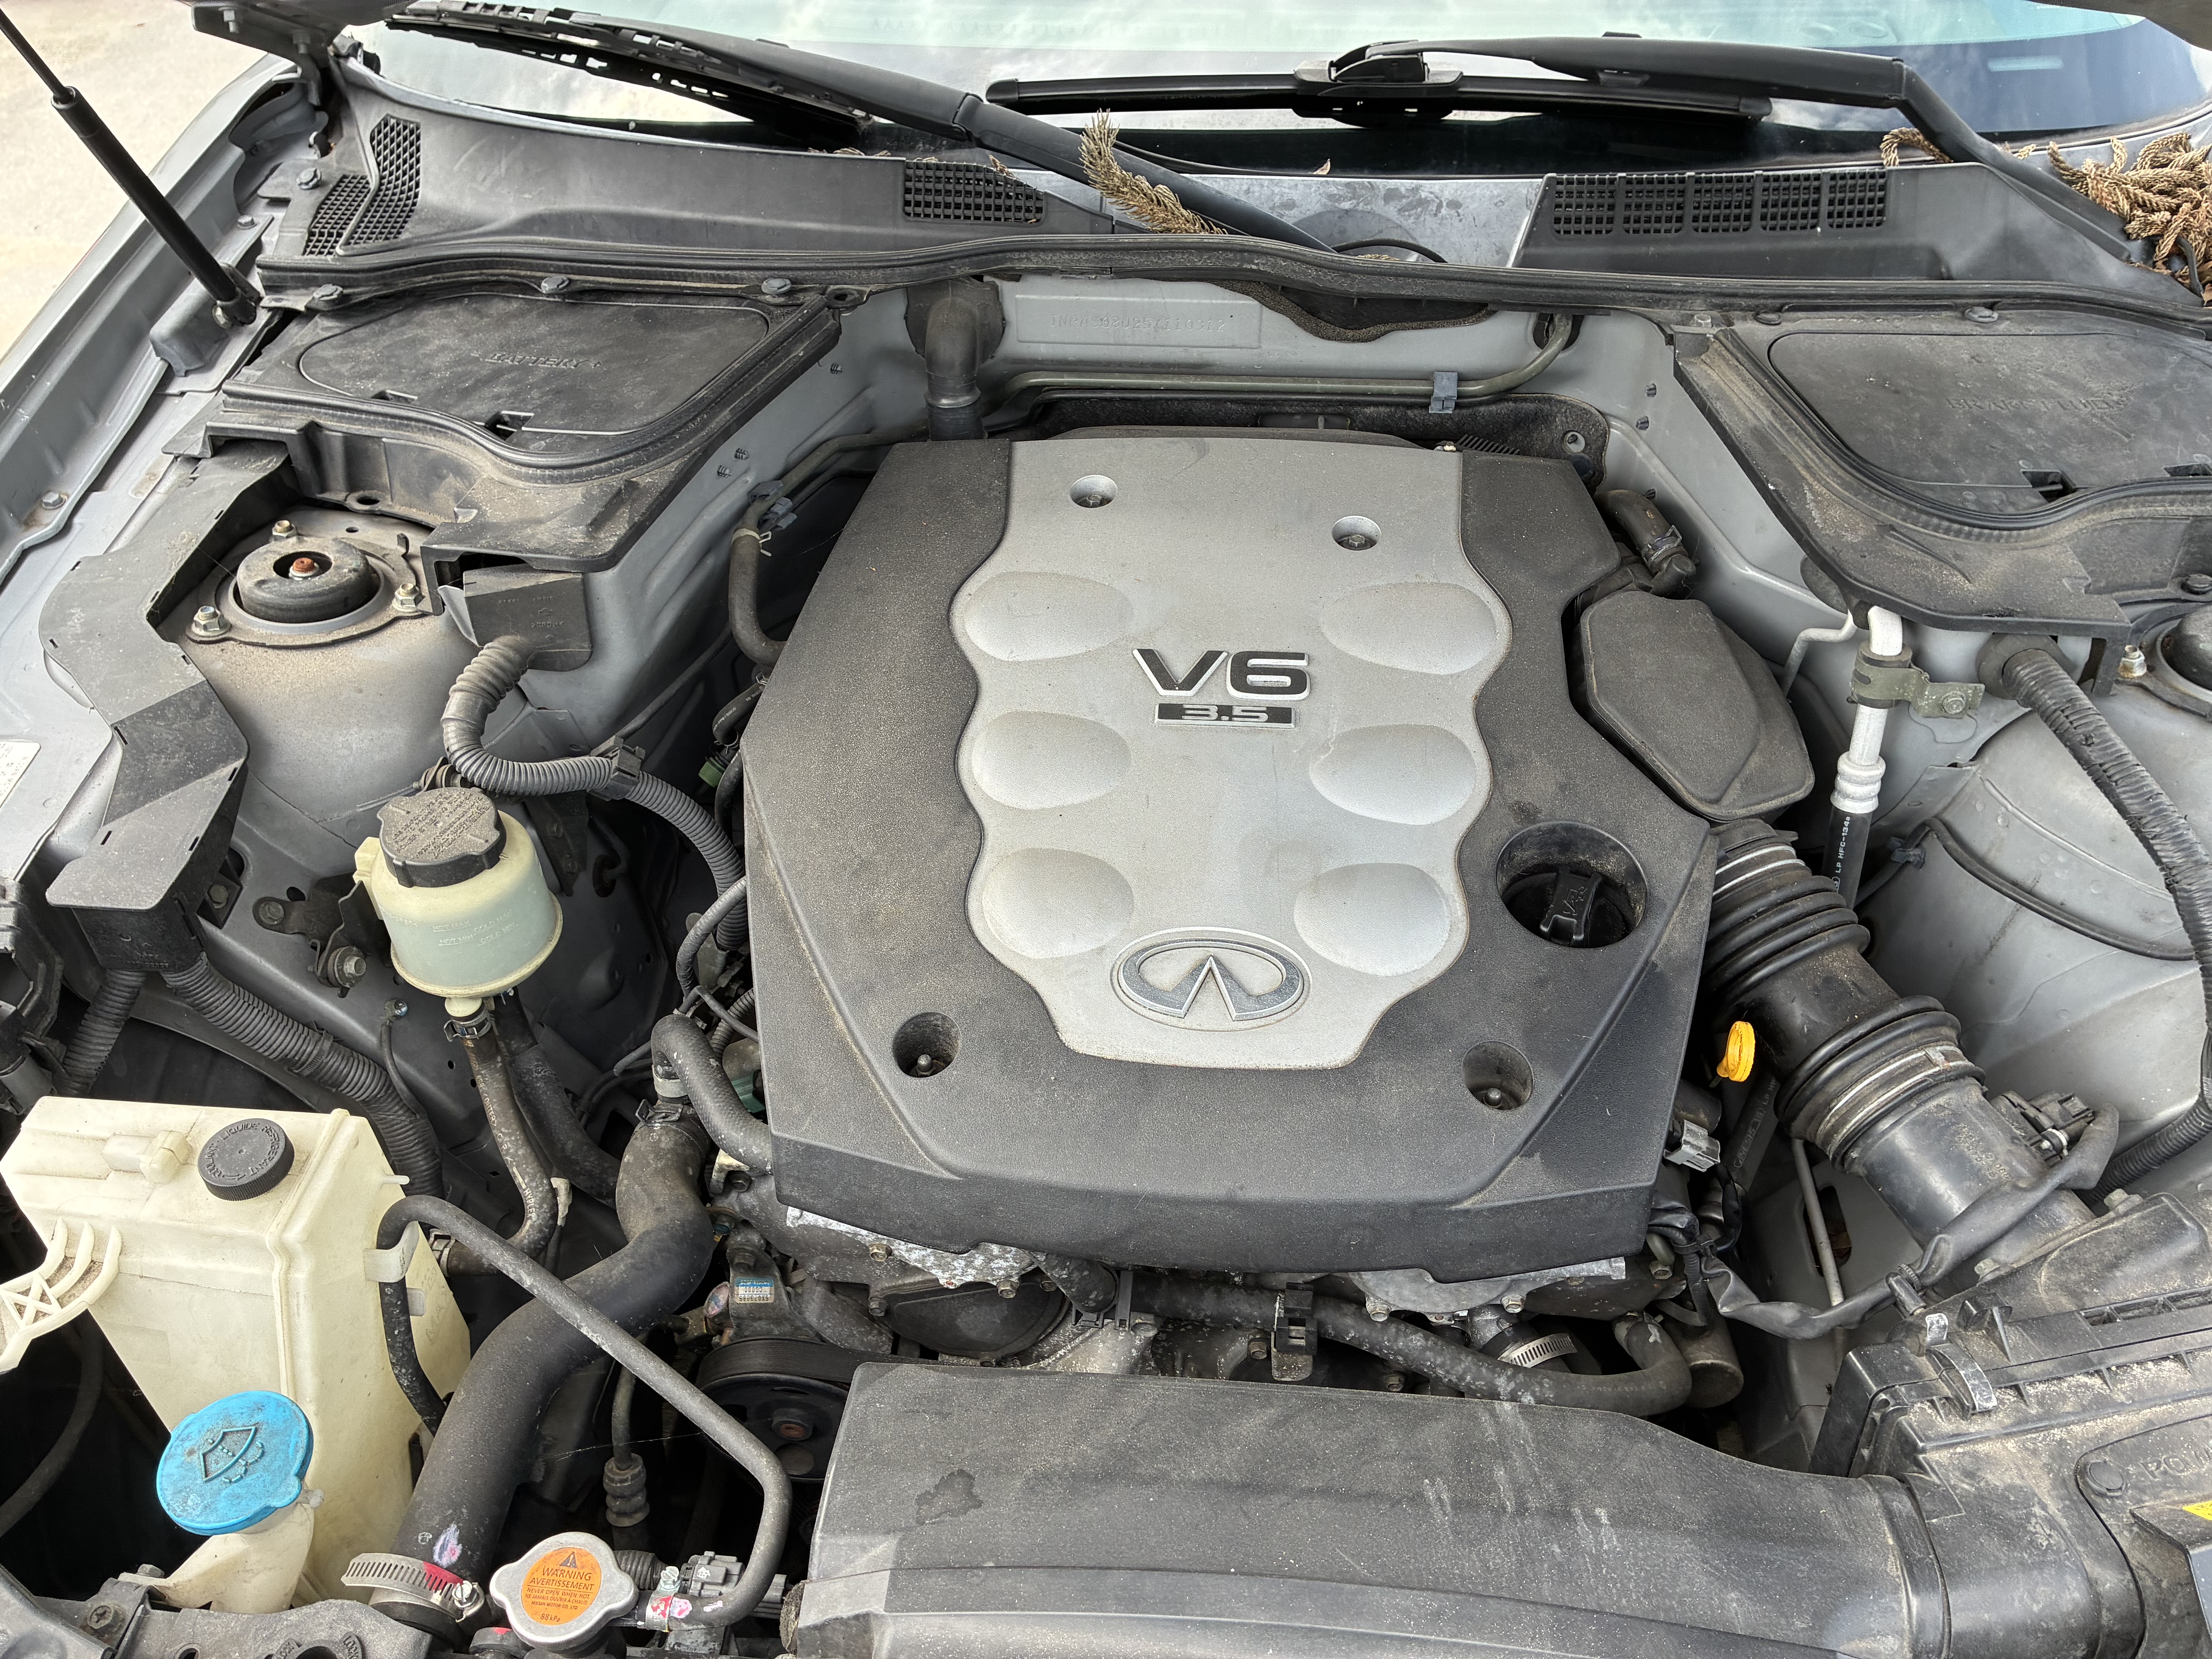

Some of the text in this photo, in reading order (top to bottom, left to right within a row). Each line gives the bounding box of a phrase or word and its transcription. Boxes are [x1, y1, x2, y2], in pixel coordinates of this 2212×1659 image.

[485, 352, 588, 368] BATTERY
[1132, 648, 1311, 700] V6
[1182, 704, 1269, 722] 3.5
[1835, 862, 1842, 873] LP
[204, 1143, 222, 1178] COOLANT
[220, 1122, 260, 1140] LIQUIDE
[542, 1565, 592, 1581] WARNING
[529, 1577, 595, 1590] AVERTISSEMENT
